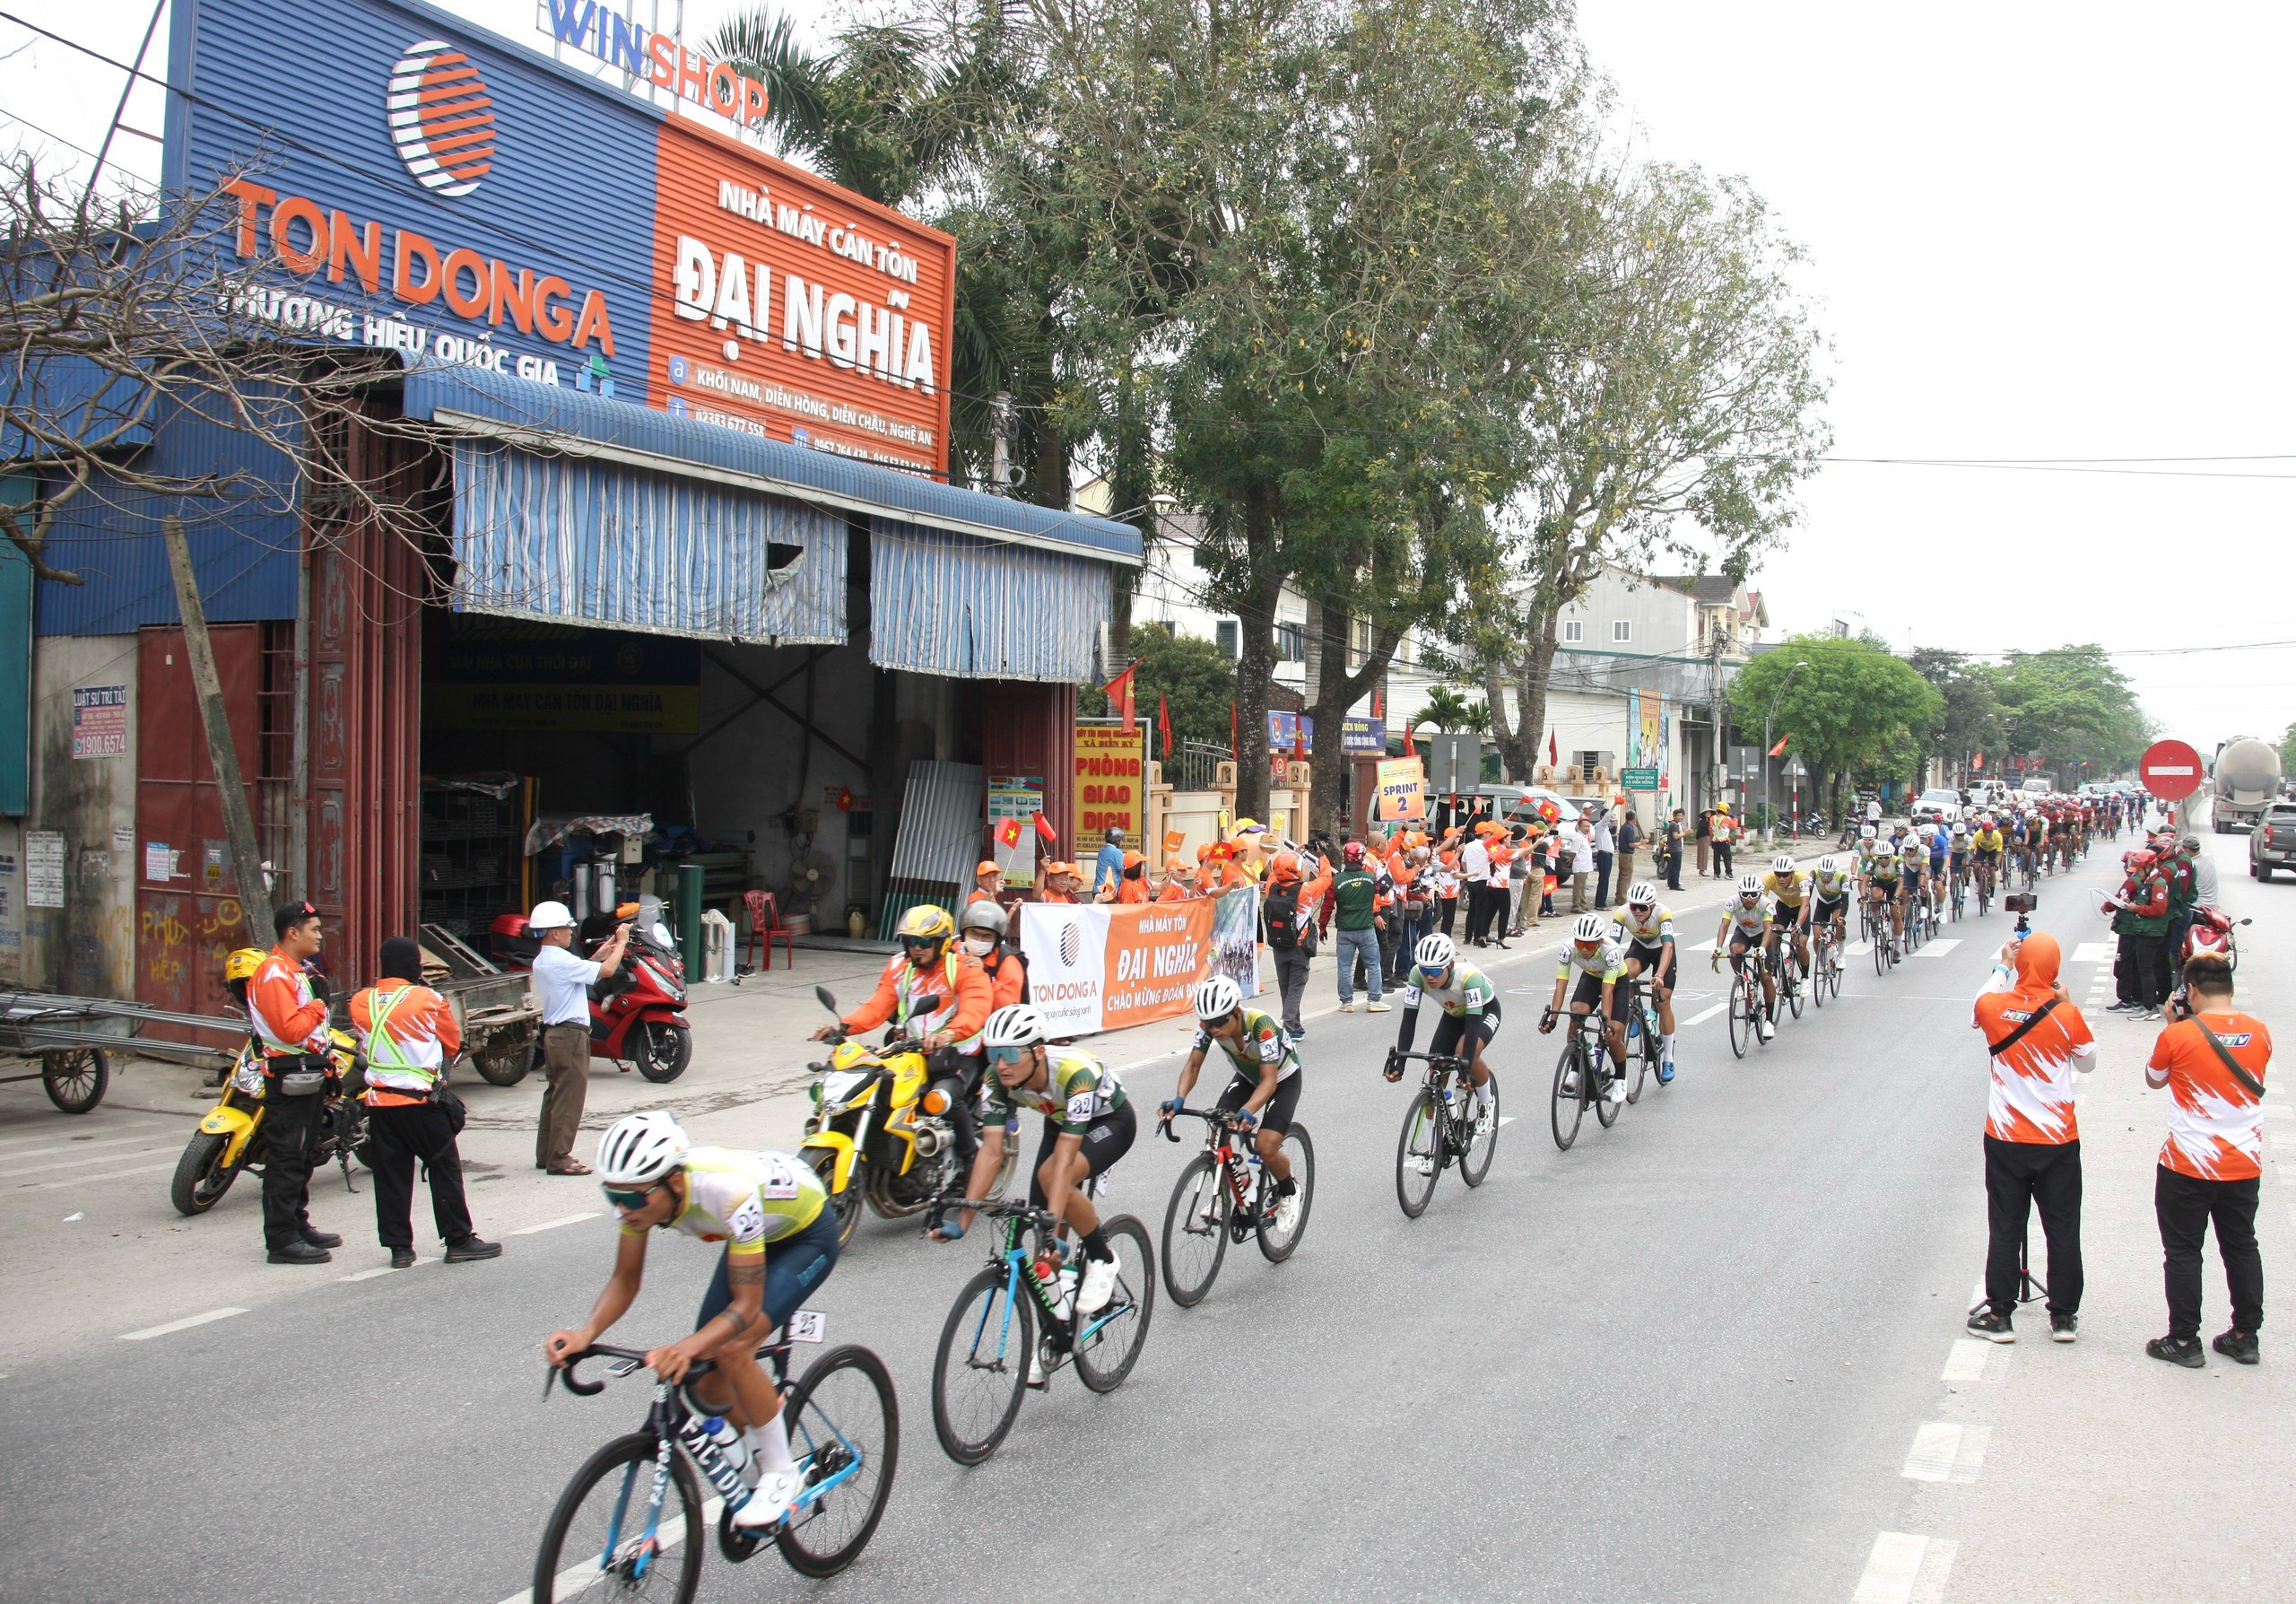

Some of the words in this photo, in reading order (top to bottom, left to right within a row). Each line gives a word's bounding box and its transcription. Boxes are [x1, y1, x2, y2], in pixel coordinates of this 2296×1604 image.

[221, 176, 382, 294] TON
[718, 179, 774, 228] NHÀ
[777, 205, 829, 247] MÁY
[829, 222, 874, 266] CÁN
[877, 241, 918, 284] TÔN
[674, 234, 771, 362] ĐẠI
[782, 274, 935, 396] NGHĨA
[435, 331, 509, 375] QUỐC
[517, 355, 560, 387] GIA
[697, 369, 728, 394] KHỐI
[731, 379, 761, 402] NAM,
[765, 385, 792, 410] DIỄN
[794, 393, 830, 421] HỒNG,
[832, 404, 857, 425] DIỄN
[858, 414, 888, 436] CHÂU,
[890, 423, 917, 445] NGHỆ
[918, 432, 932, 447] AN
[727, 417, 746, 434] 677
[748, 423, 765, 438] 558
[74, 688, 91, 707] LUẬT
[91, 689, 100, 705] SƯ
[82, 735, 126, 754] 1900.6574
[1075, 753, 1141, 777] PHÒNG
[1083, 785, 1131, 804] GIAO
[1384, 782, 1418, 797] SPRINT
[1397, 796, 1408, 812] 2
[1083, 811, 1131, 833] DỊCH
[1139, 915, 1155, 934] NHÀ
[1155, 913, 1173, 933] MÁY
[1174, 913, 1188, 931] TÔN
[1661, 924, 1671, 932] 35
[1117, 946, 1148, 988] ĐẠI
[1153, 936, 1198, 978] NGHĨA
[1608, 952, 1619, 963] 24
[1033, 984, 1055, 1003] TON
[1107, 989, 1133, 1011] CHÀO
[1134, 986, 1161, 1007] MỪNG
[1162, 981, 1185, 1002] ĐOÀN
[1466, 991, 1479, 1003] 34
[1074, 1096, 1091, 1115] 32
[799, 1313, 817, 1336] 25
[679, 1415, 751, 1508] FACTOR
